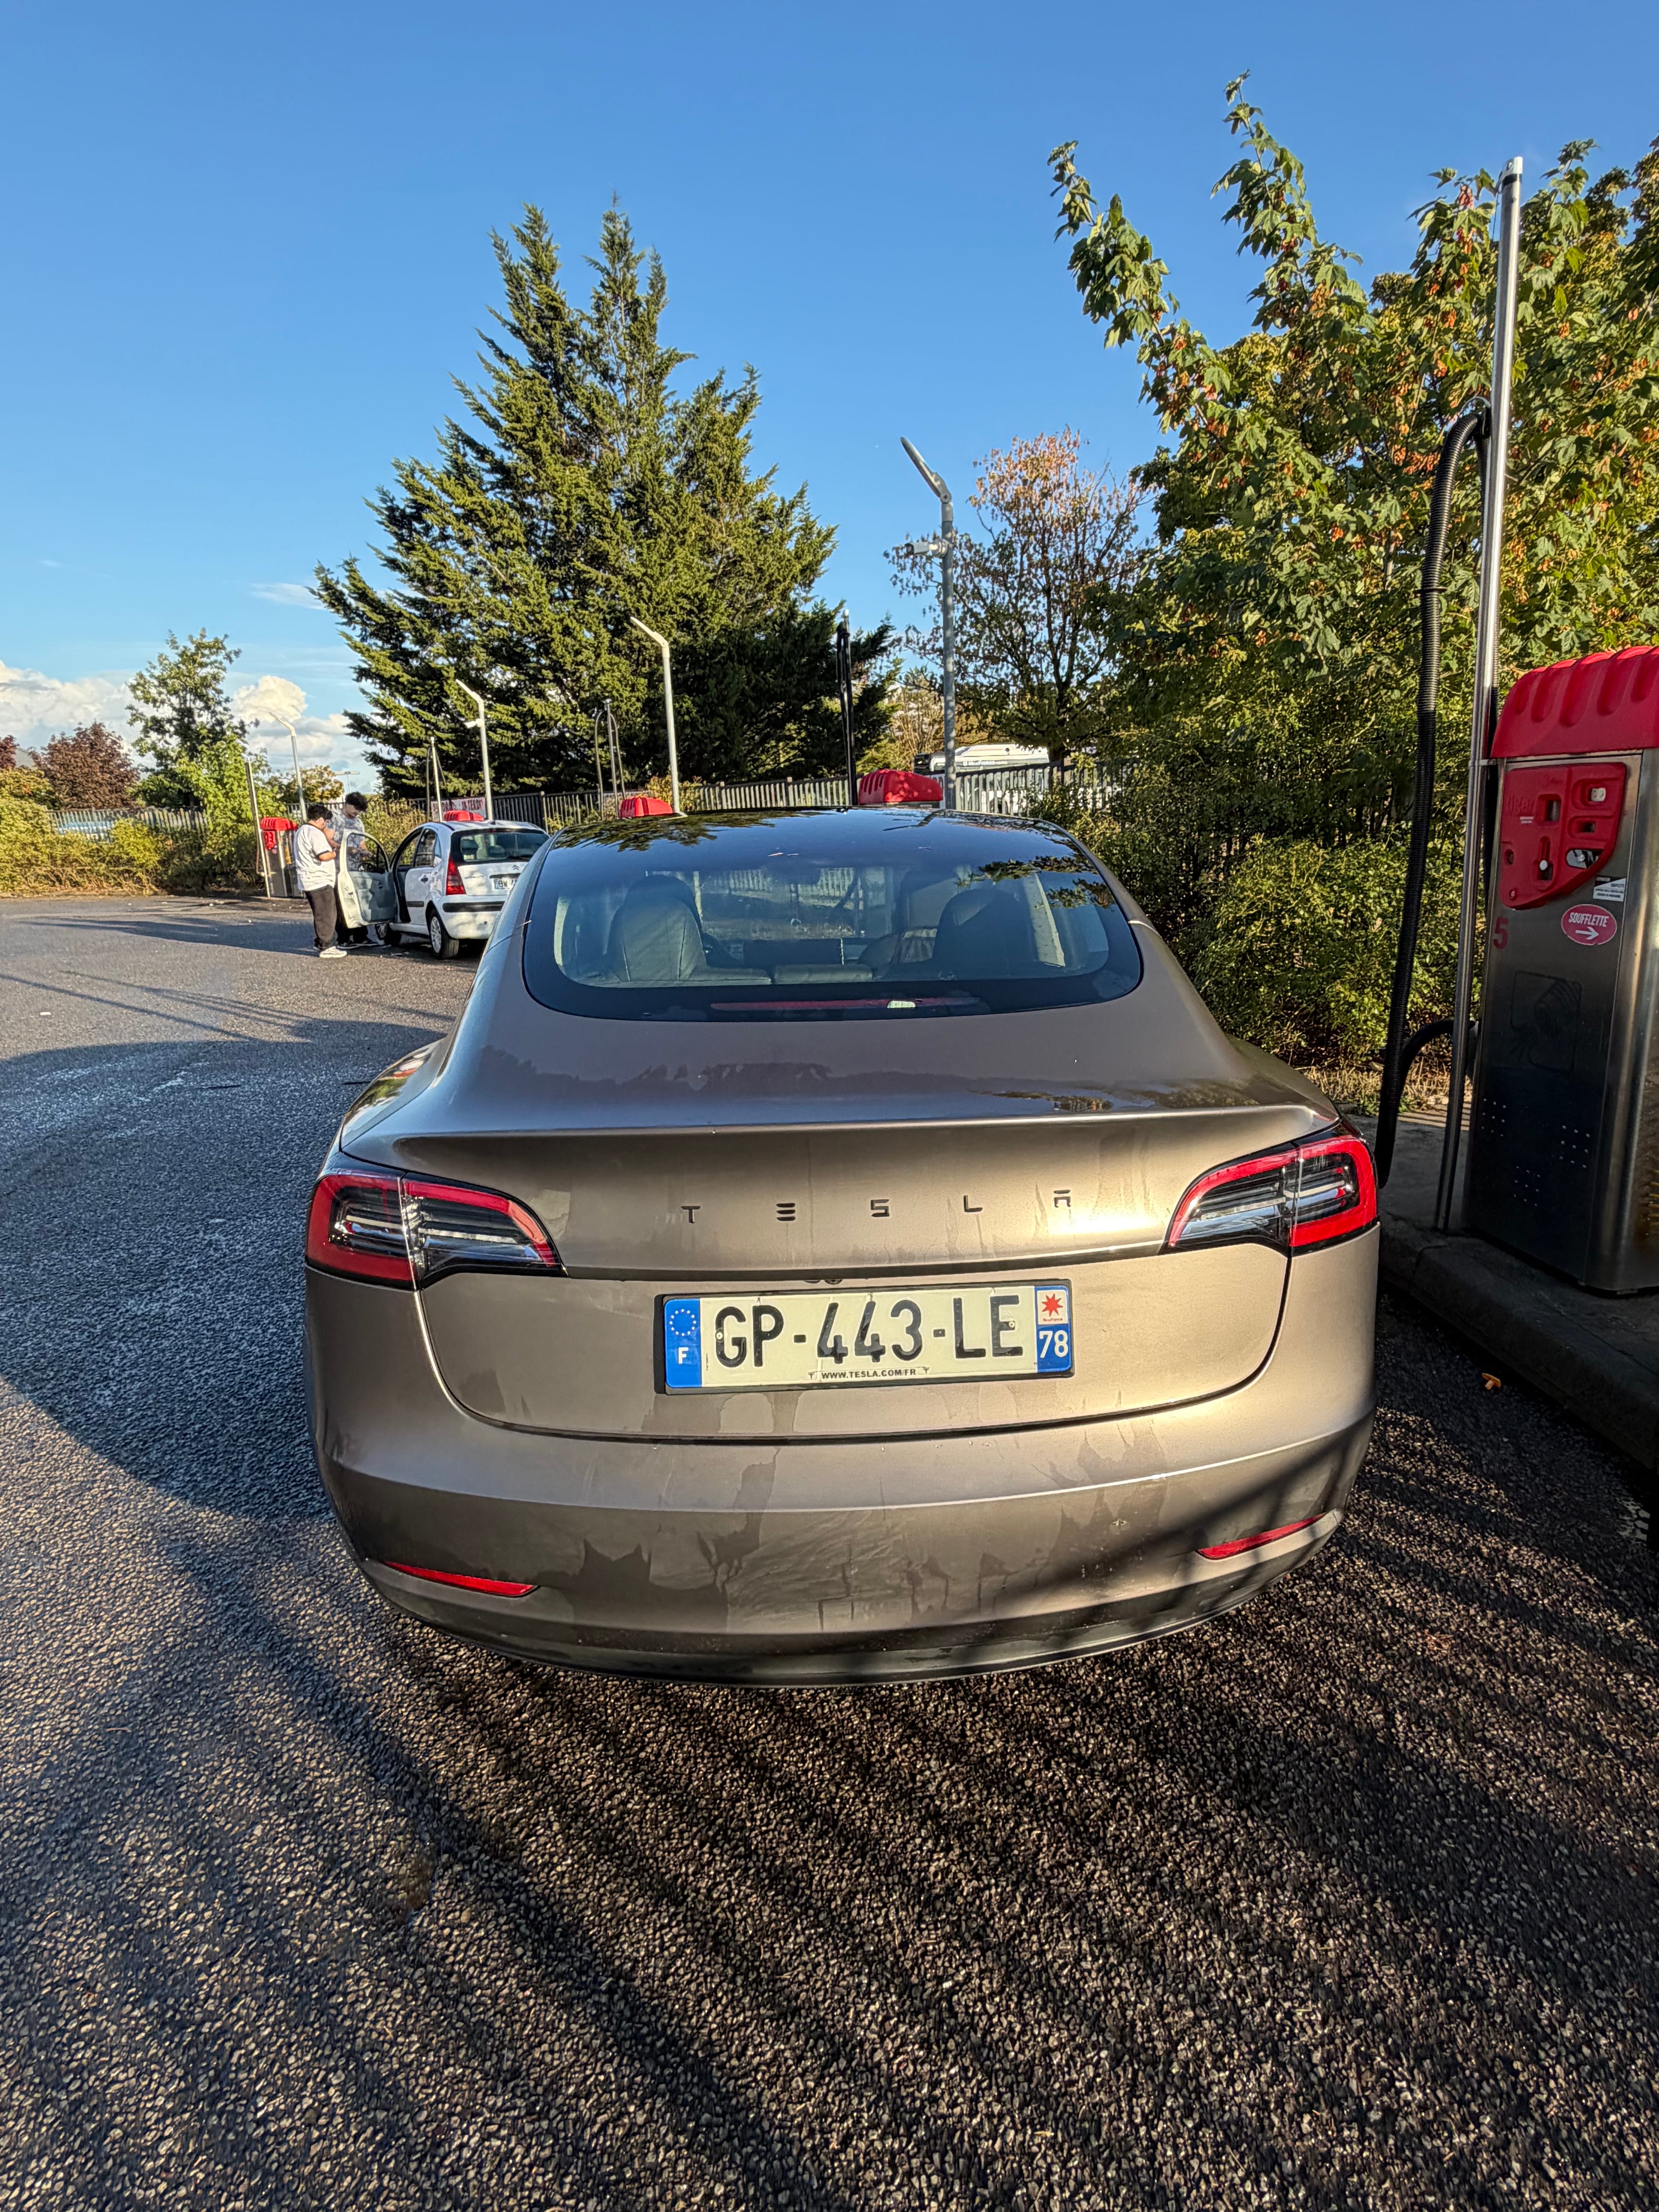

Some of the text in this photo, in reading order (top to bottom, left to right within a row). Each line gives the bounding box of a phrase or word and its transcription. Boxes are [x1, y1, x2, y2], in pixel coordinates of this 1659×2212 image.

[1493, 917, 1509, 950] 5
[1568, 912, 1609, 927] SOUFFLETTE
[681, 1190, 1071, 1224] TESLA
[715, 1295, 1023, 1368] GP-443-LE
[1039, 1330, 1068, 1358] 78
[678, 1346, 689, 1364] F
[821, 1368, 916, 1379] WWW.TESLA.COM/FR
